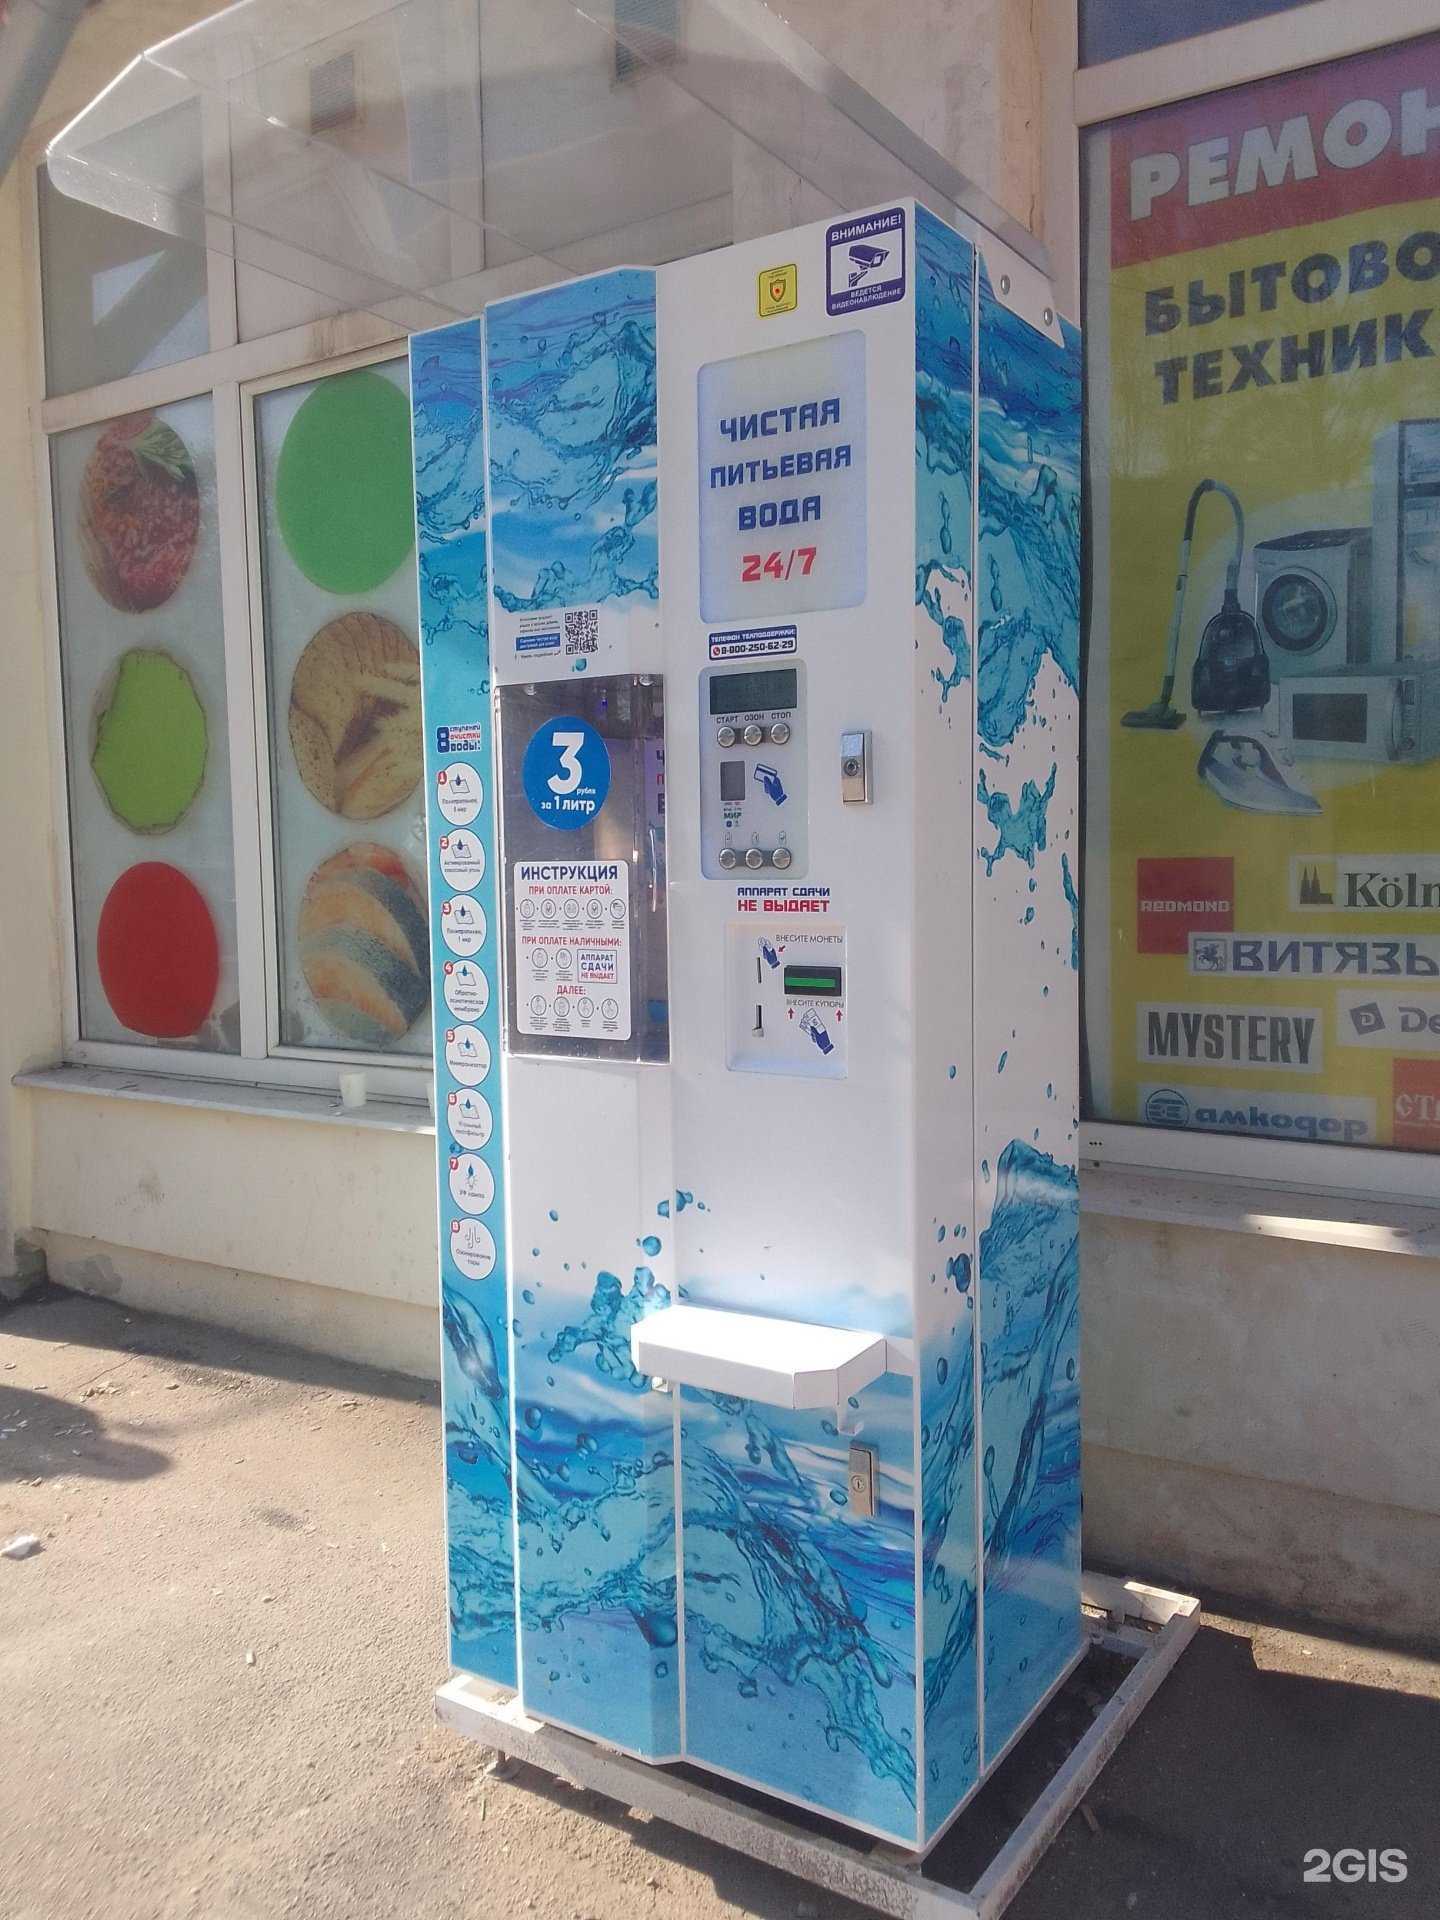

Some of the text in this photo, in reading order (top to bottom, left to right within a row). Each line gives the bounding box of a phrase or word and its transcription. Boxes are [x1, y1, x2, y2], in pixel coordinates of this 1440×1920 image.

[831, 214, 902, 241] ВНИМАНИЕ!
[851, 285, 881, 298] ВЕДЕТСЯ
[1144, 231, 1440, 336] БЫТОВО
[831, 287, 902, 310] ВИДЕОНАБЛЮДЕНИЕ
[1155, 308, 1436, 405] ТЕХНИК
[720, 397, 840, 442] ЧИСТАЯ
[710, 444, 851, 489] ПИТЬЕВАЯ
[738, 495, 821, 531] ВОДА
[742, 547, 817, 583] 24/7
[711, 634, 740, 643] ТЕЛЕФОН
[721, 640, 794, 655] 8-800-250-62-29
[717, 712, 791, 724] СТАРТ ОЗОН СТОП
[437, 727, 450, 753] 8
[547, 732, 585, 795] 3
[541, 796, 595, 815] за 1 литр
[521, 865, 618, 882] ИНСТРУКЦИЯ
[529, 884, 613, 895] ПРИ ОПЛАТЕ КАРТОЙ:
[737, 887, 830, 897] АППАРАТ СДАЧИ
[737, 900, 830, 912] НЕ ВЫДАЕТ
[1141, 901, 1230, 912] REDMOND
[522, 936, 622, 947] ПРИ ОПЛАТЕ НАЛИЧНЫМИ:
[775, 934, 843, 944] ВНЕСИТЕ МОНЕТЫ
[1232, 940, 1440, 976] ВИТЯЗЬ
[581, 962, 613, 972] СДАЧИ
[590, 972, 614, 980] ВЫДАЕТ
[557, 985, 586, 995] ДАЛЕЕ:
[786, 999, 844, 1008] ВНЕСИТЕ КУПЮРЫ
[1148, 1011, 1315, 1065] MYSTERY
[1195, 1107, 1368, 1141] амкодор
